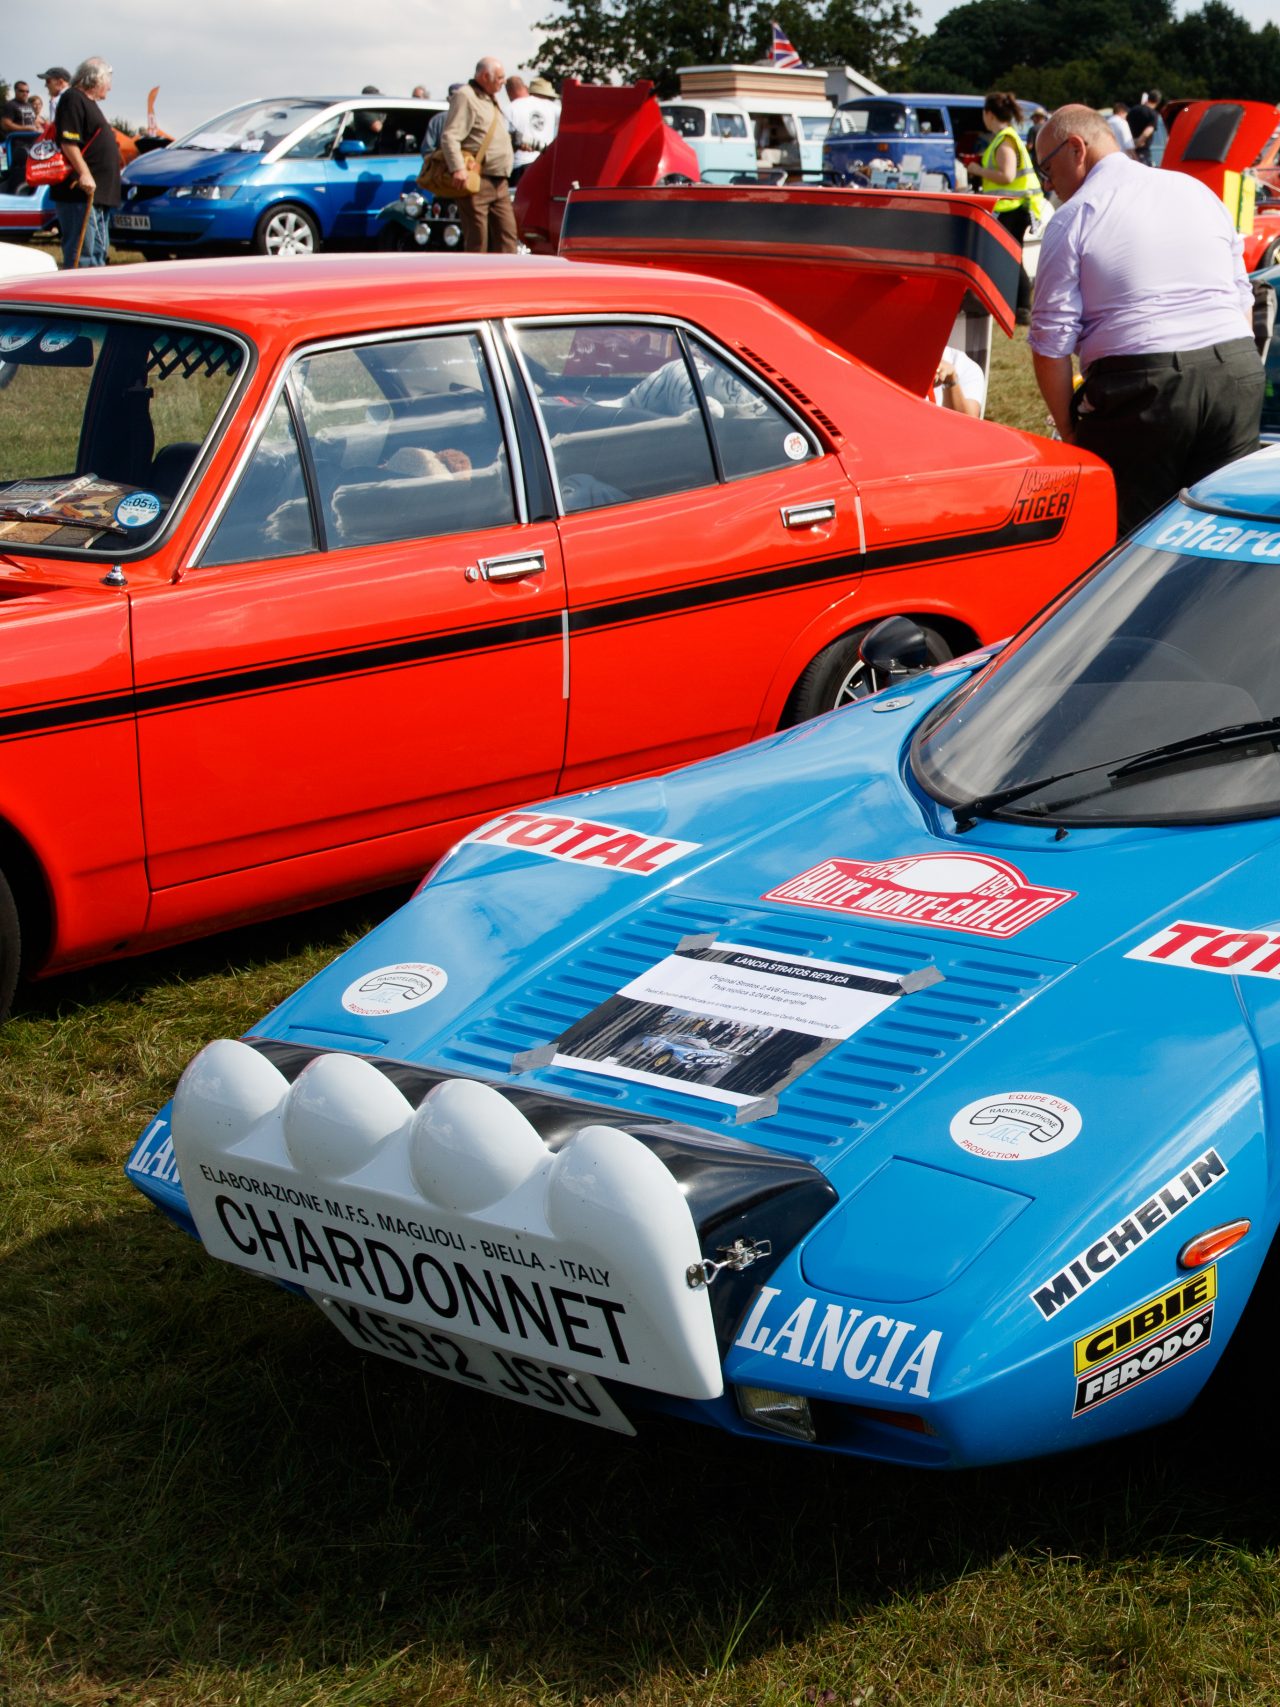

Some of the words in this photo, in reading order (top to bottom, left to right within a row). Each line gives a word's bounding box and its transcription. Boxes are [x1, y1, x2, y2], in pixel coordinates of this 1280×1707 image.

[1017, 493, 1070, 522] TIGER
[475, 814, 679, 872] TOTAL
[855, 859, 918, 878] 1979
[776, 862, 873, 908] RALLYE
[853, 884, 1055, 933] MONTE-CARLO
[972, 873, 1019, 898] 1979
[733, 956, 768, 968] LANCIA
[768, 963, 811, 977] STRATOS
[808, 971, 850, 984] REPLICA
[709, 974, 736, 985] Original
[735, 980, 760, 989] Stratos
[802, 993, 827, 1002] engine
[712, 983, 725, 992] This
[726, 987, 748, 996] replica
[783, 998, 807, 1006] engine
[1008, 1093, 1049, 1103] EQUIPE
[1049, 1099, 1072, 1113] D'UN
[989, 1108, 1058, 1129] RADIOTELEPHONE
[961, 1139, 1020, 1160] PRODUCTION
[200, 1164, 323, 1213] ELABORAZIONE
[326, 1201, 376, 1229] M.F.S.
[378, 1213, 467, 1252] MAGLIOLI
[479, 1240, 546, 1272] BIELLA
[559, 1259, 611, 1288] ITALY
[1033, 1150, 1226, 1317] MICHELIN
[215, 1194, 631, 1365] CHARDONNET
[336, 1304, 488, 1383] K532
[735, 1286, 943, 1399] LANCIA
[1084, 1322, 1204, 1403] FERODO
